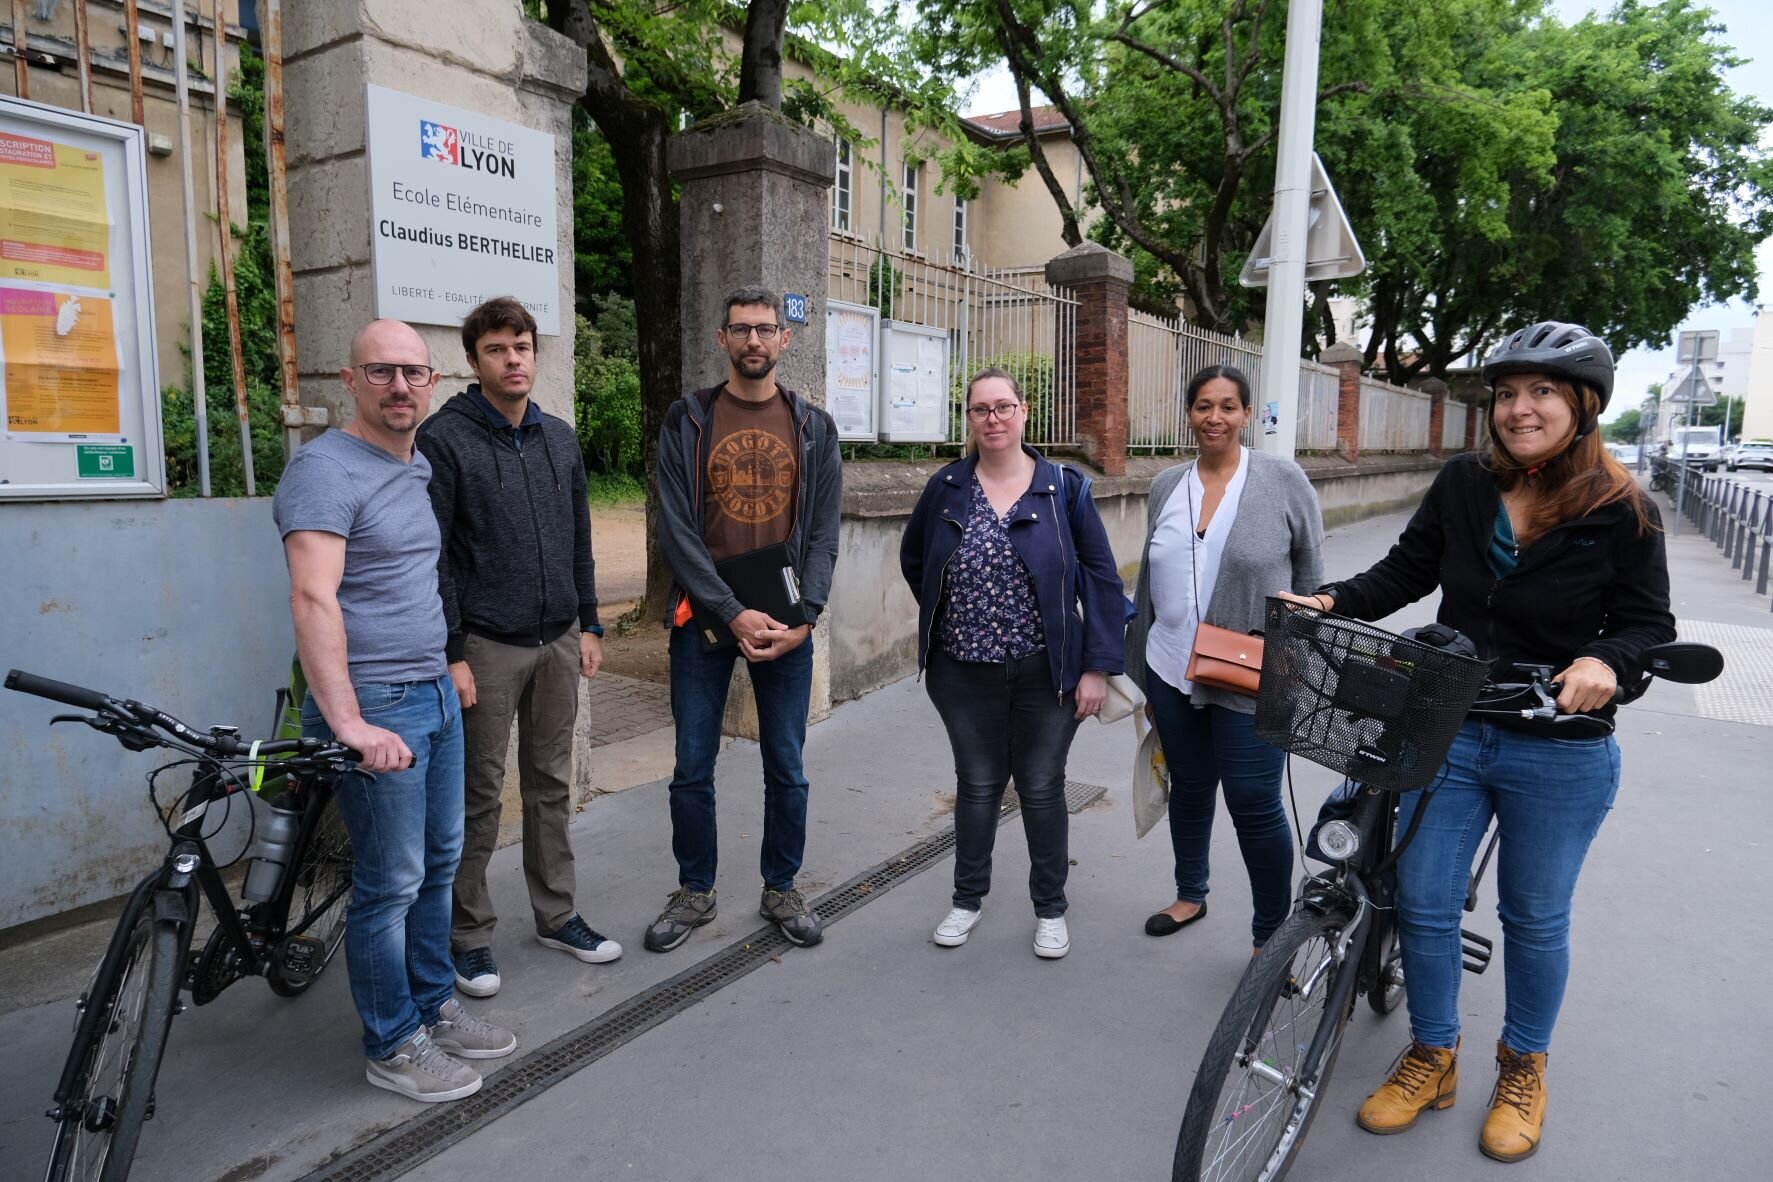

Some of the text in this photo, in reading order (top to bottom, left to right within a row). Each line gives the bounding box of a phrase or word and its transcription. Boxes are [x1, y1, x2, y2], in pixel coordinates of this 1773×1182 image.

[459, 129, 514, 156] VILLE DE
[460, 145, 515, 179] LYON
[392, 181, 542, 228] Ecole Elémentaire
[379, 219, 554, 264] Claudius BERTHELIER
[392, 285, 435, 300] LIBERTÉ
[787, 297, 804, 319] 183
